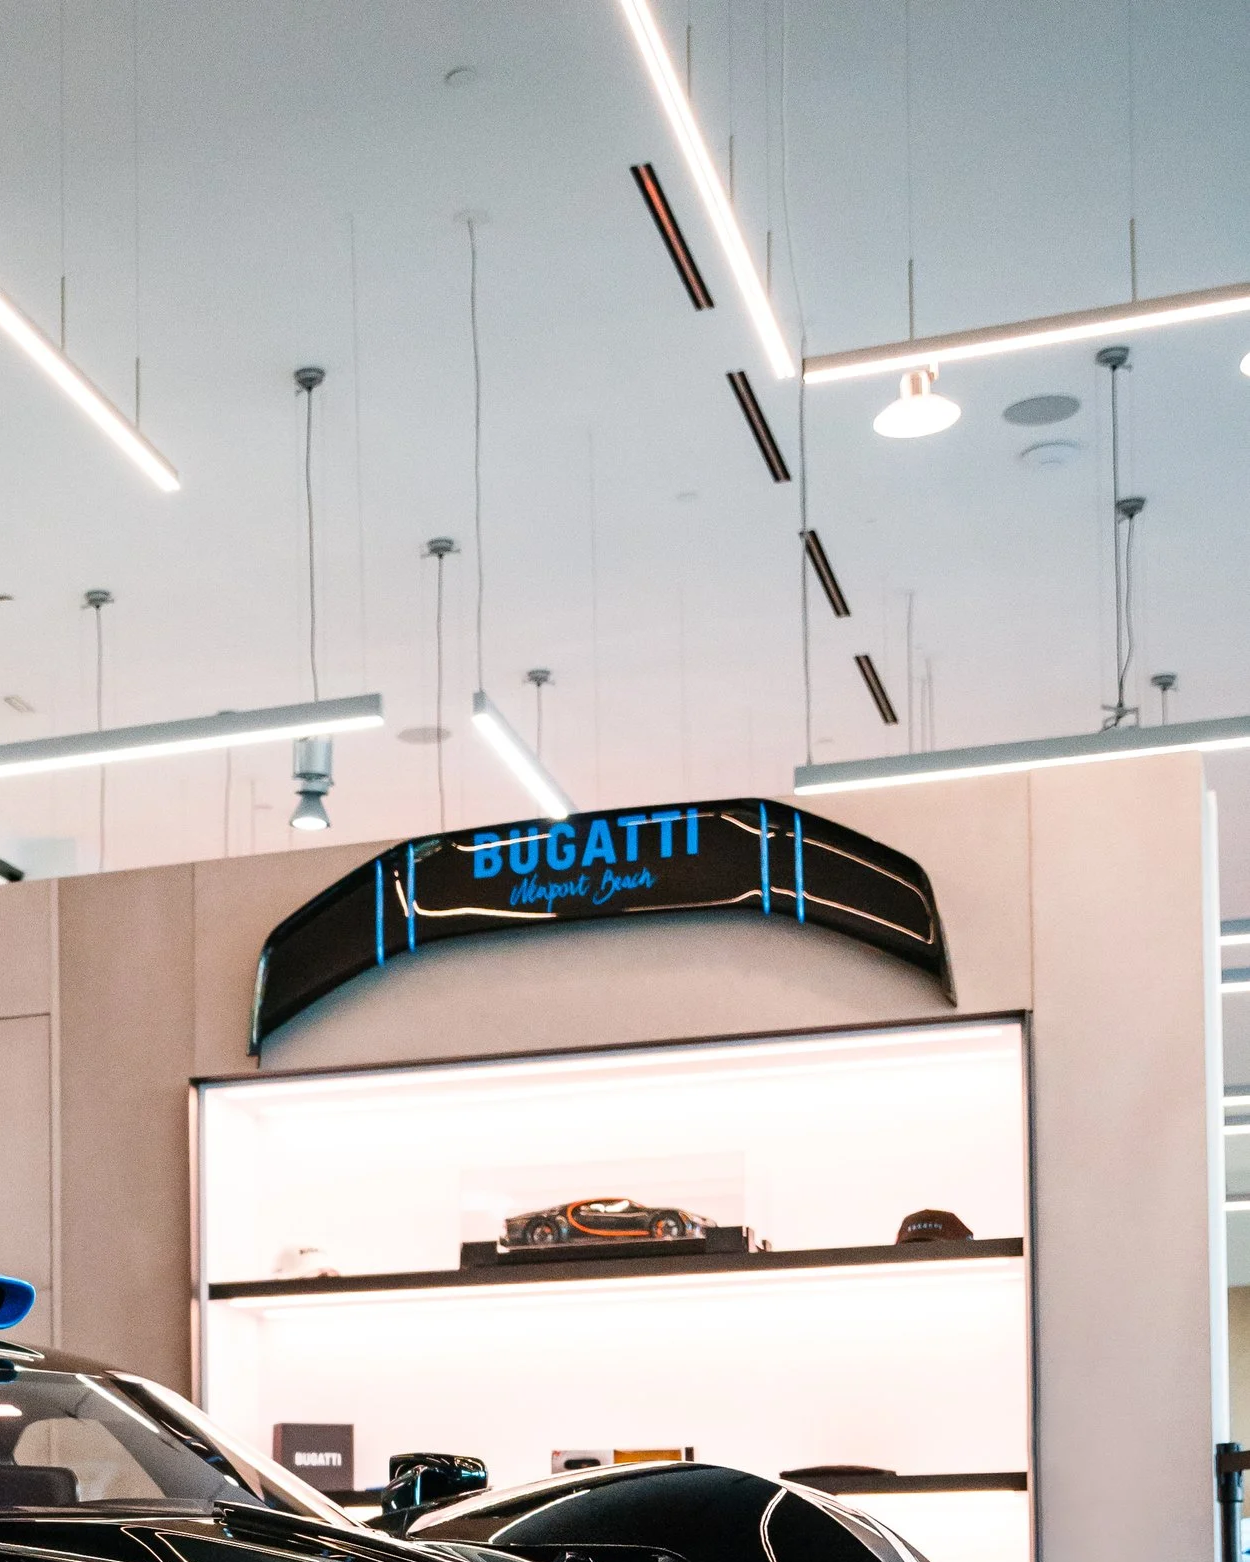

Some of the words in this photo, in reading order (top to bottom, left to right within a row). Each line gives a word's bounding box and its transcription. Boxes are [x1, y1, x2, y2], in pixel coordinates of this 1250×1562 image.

[473, 808, 699, 879] BUGATTI
[510, 873, 590, 912] Newport
[592, 867, 659, 905] Beach
[294, 1452, 342, 1467] BUGATTI
